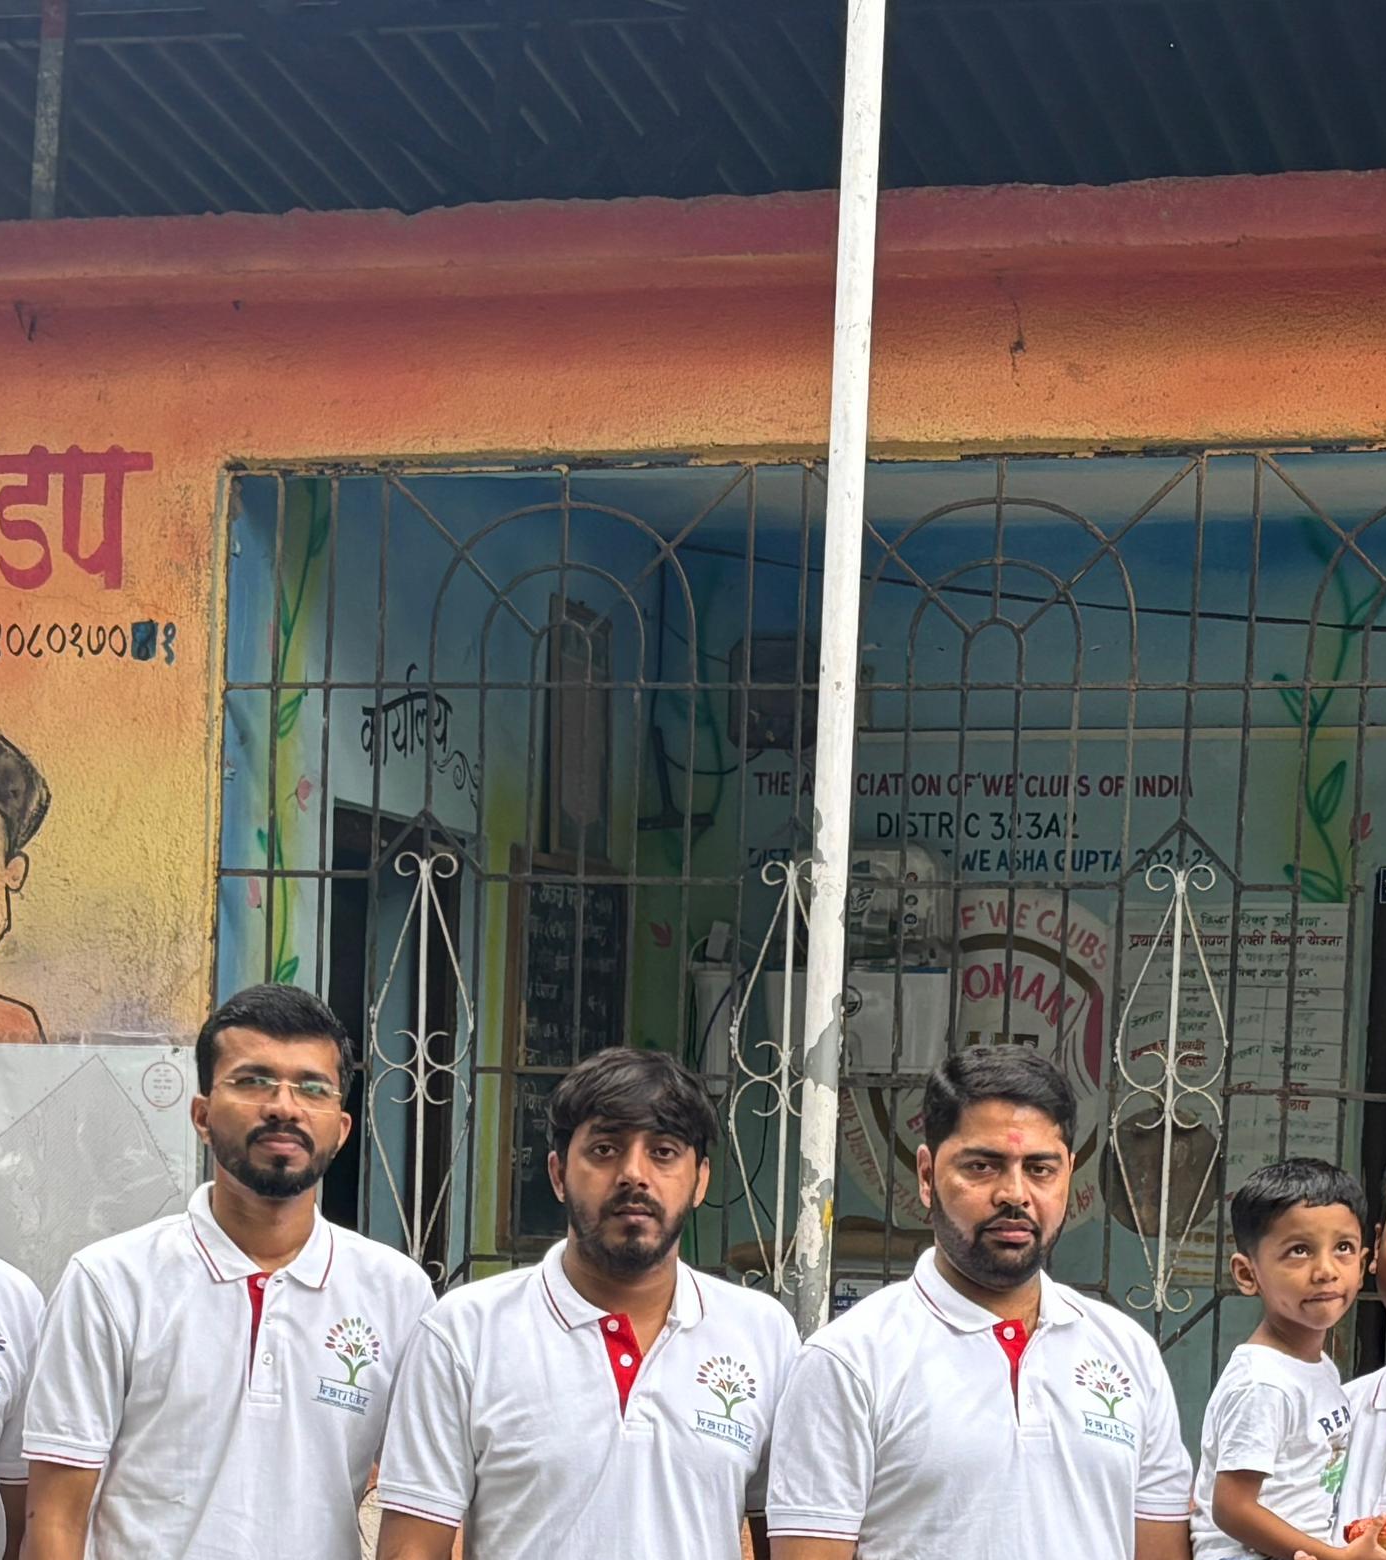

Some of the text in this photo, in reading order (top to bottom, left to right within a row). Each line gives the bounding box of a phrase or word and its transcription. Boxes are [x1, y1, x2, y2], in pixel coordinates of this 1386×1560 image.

[753, 771, 791, 797] THE
[800, 771, 942, 797] ACIATON
[1099, 775, 1125, 798] OF
[877, 811, 981, 839] DISTRC
[963, 961, 1077, 1028] OMAN
